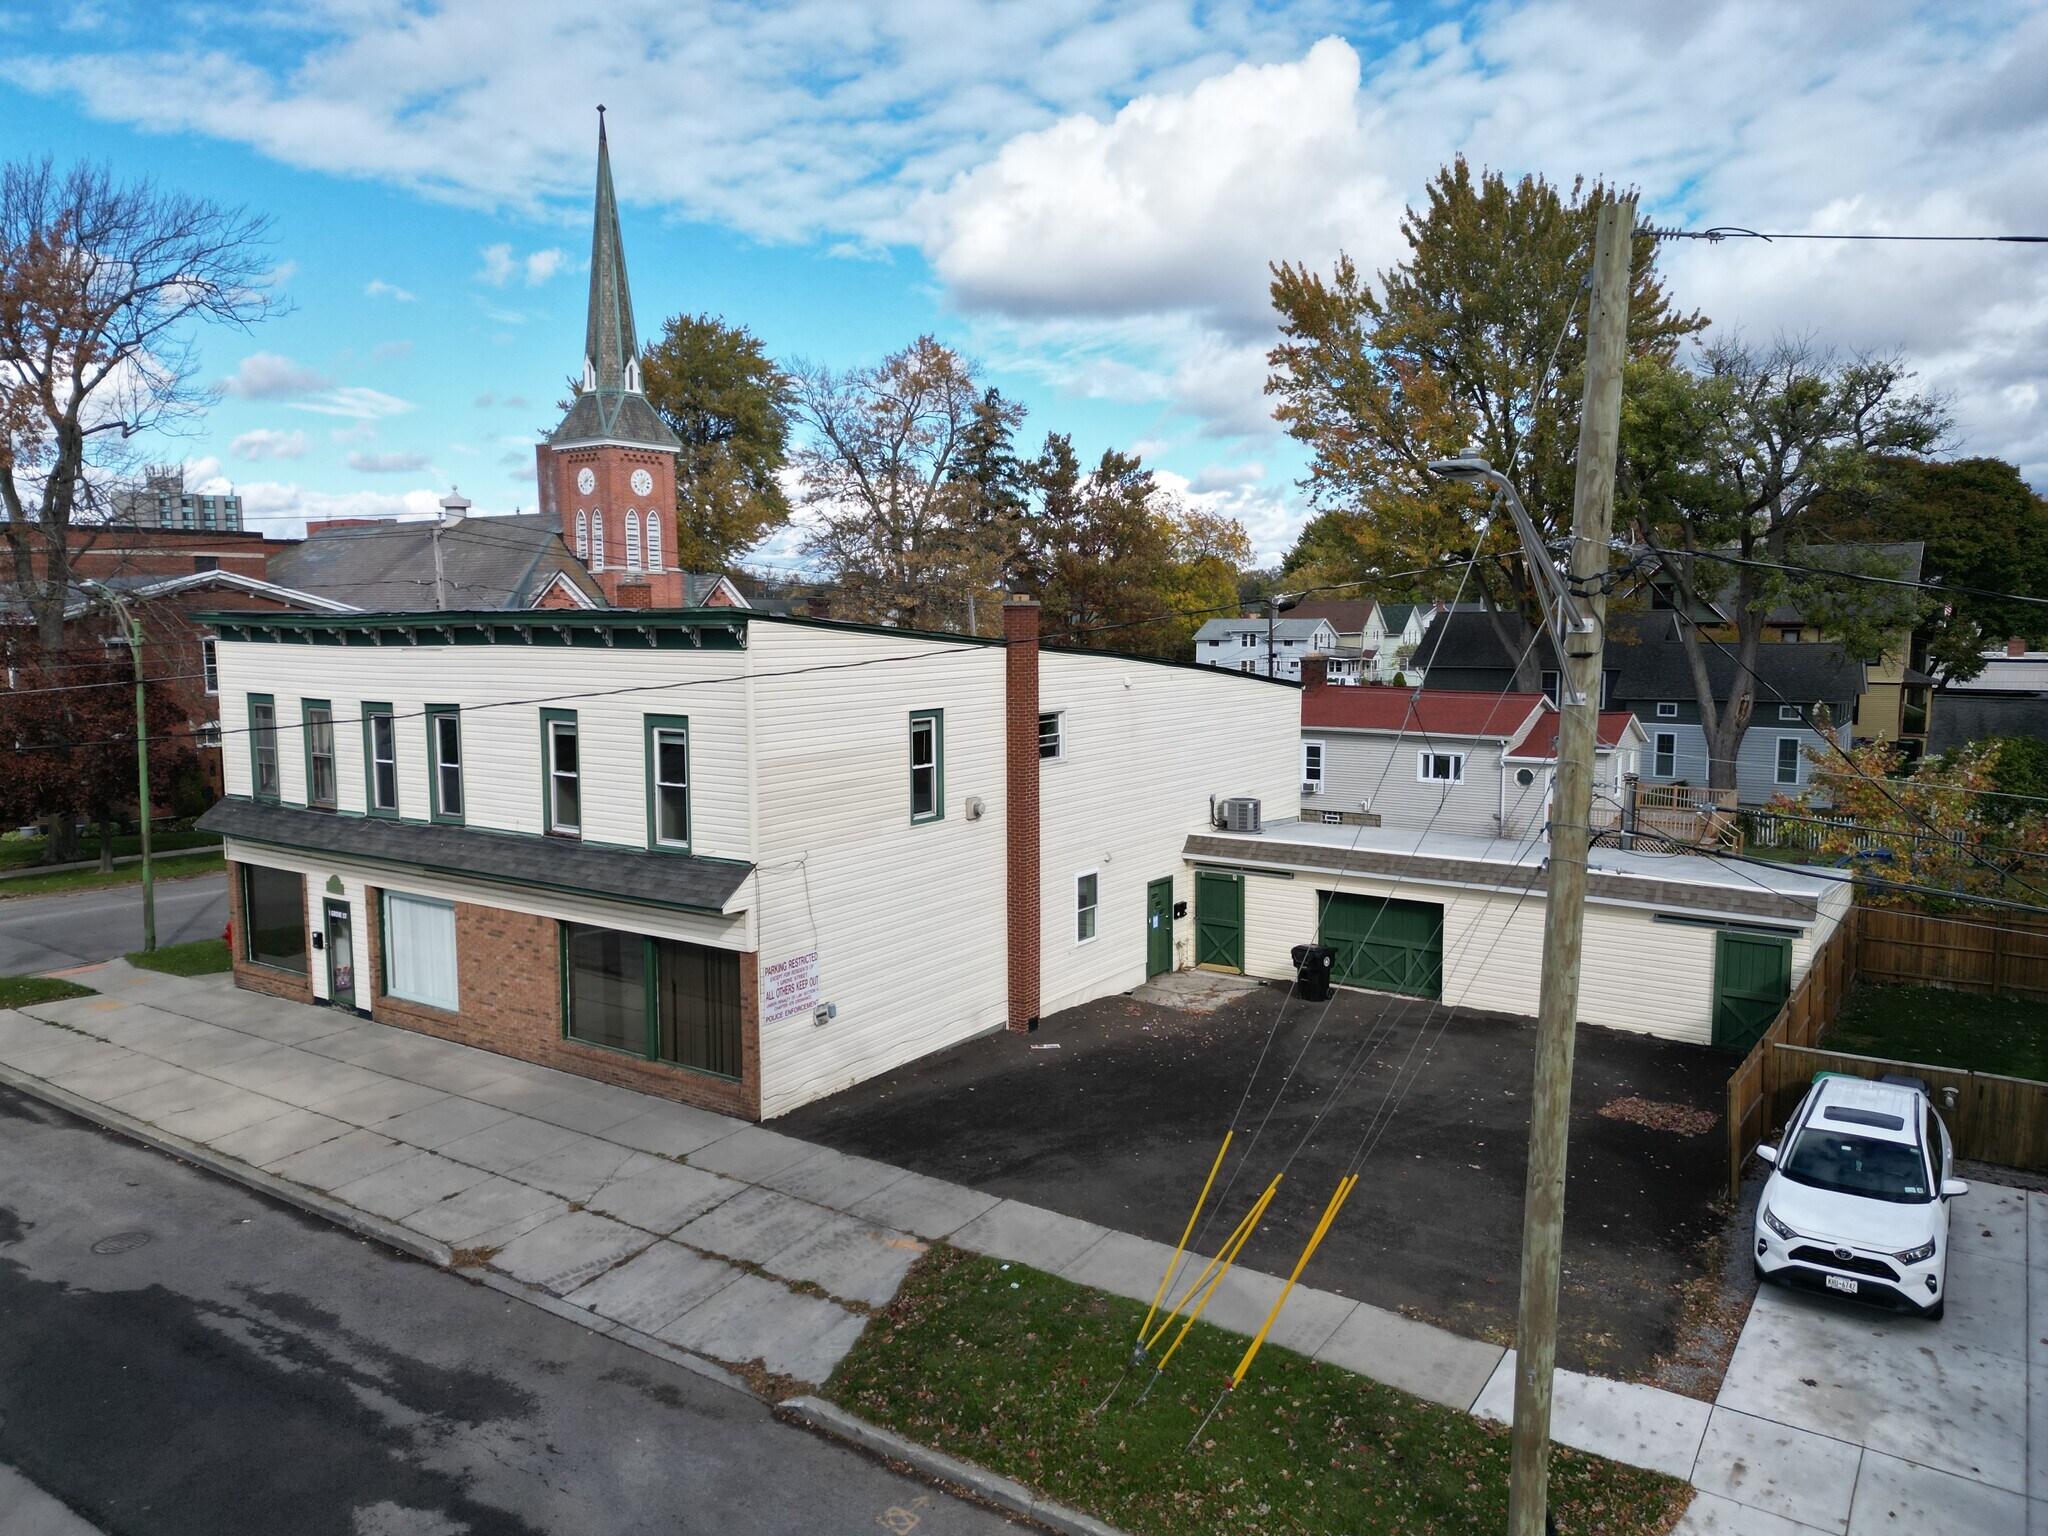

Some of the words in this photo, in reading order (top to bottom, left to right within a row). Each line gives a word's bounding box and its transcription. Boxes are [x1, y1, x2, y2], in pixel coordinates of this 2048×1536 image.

[765, 962, 787, 976] PARKING
[789, 952, 818, 969] RESTRICTED
[770, 973, 782, 982] EXCEPT
[791, 966, 809, 975] RESIDENTS
[794, 972, 808, 981] STREET
[766, 991, 774, 1001] ALL
[776, 984, 794, 997] OTHERS
[796, 981, 808, 990] KEEP
[809, 976, 818, 986] OUT
[766, 1012, 783, 1023] POLICE
[785, 1000, 819, 1016] ENFORCEMENT
